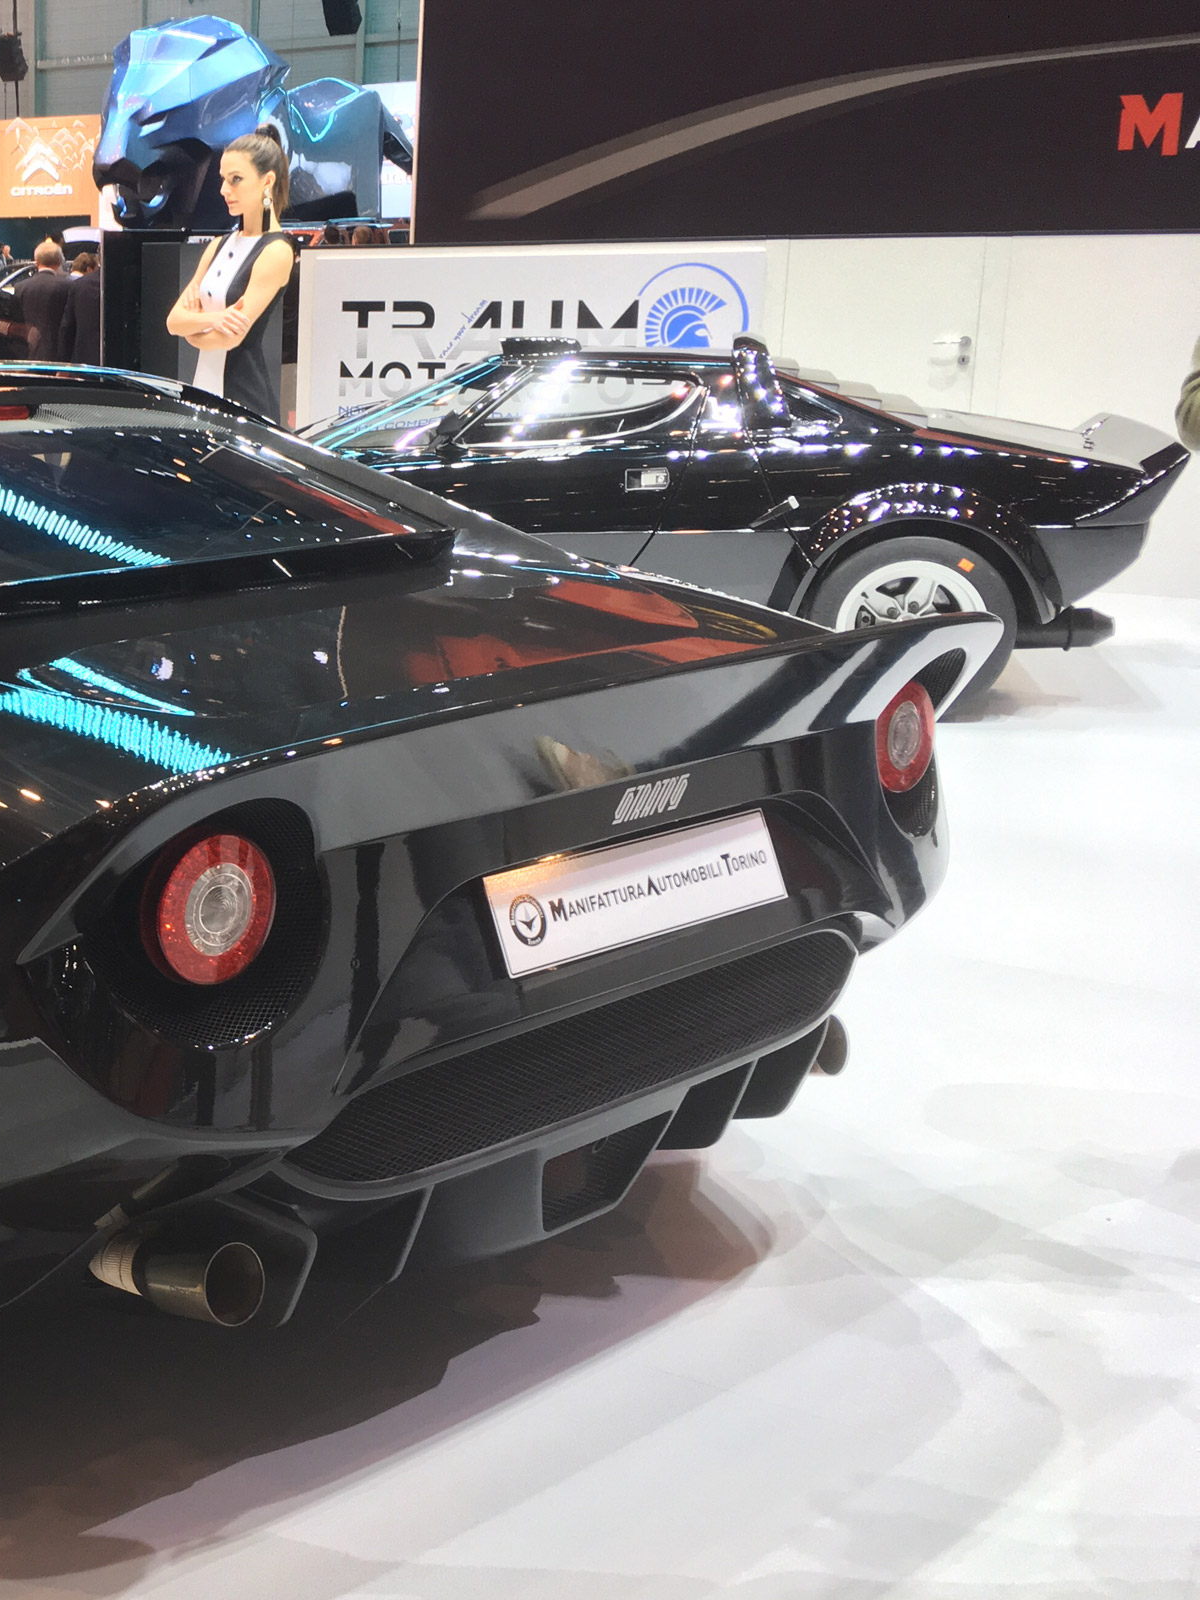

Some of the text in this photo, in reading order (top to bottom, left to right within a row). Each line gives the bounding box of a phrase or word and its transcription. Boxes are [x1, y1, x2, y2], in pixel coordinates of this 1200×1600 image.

[341, 299, 640, 359] TRAUM
[548, 882, 646, 922] MANIFATTURA
[646, 861, 723, 896] AUTOMOBILI
[720, 849, 768, 876] TORINO
